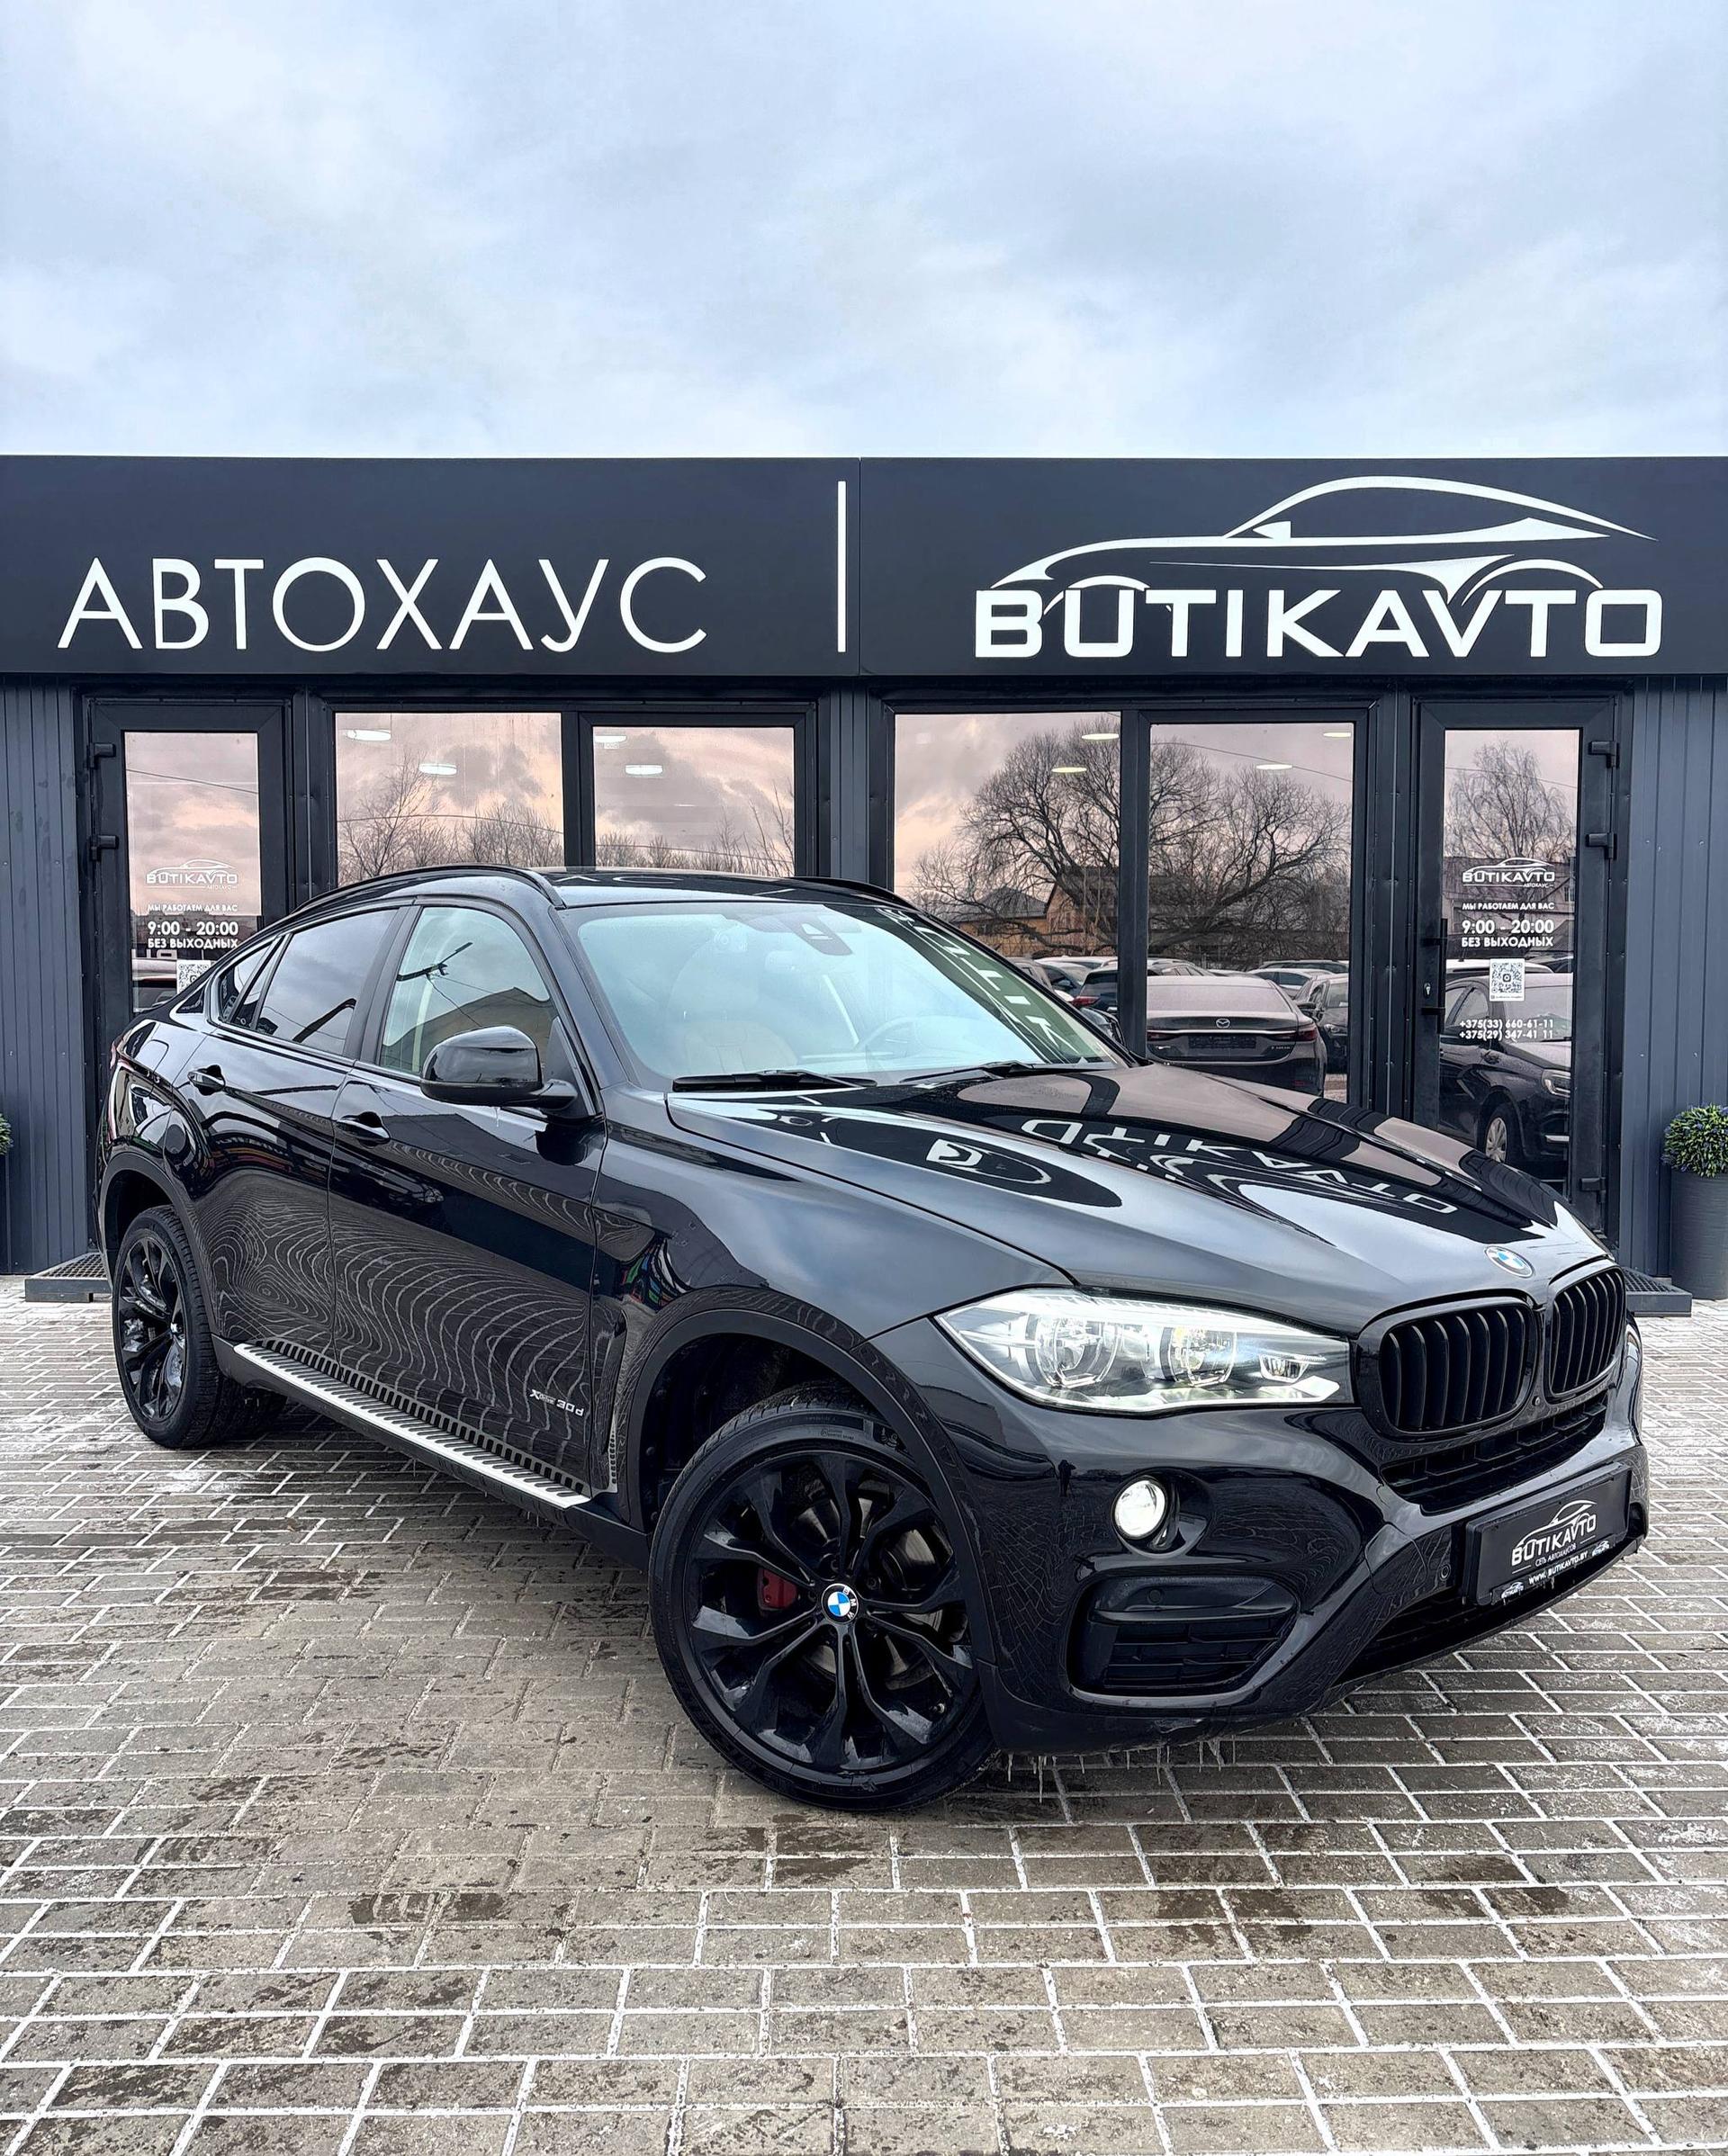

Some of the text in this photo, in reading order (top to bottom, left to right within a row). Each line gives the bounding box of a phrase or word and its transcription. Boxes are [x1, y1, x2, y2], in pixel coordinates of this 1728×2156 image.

[58, 556, 708, 653] АВТОХАУС
[975, 588, 1663, 659] BUTIKAVTO
[146, 873, 238, 884] BUTIKAVTO
[1462, 871, 1555, 883] BUTIKAVTO
[148, 903, 238, 912] МЫ РАБОТАЕМ ДЛЯ ВАС
[1520, 903, 1536, 911] ДЛЯ
[147, 921, 181, 936] 9:00
[195, 921, 239, 936] 20:00
[1462, 920, 1495, 934] 9:00
[1511, 919, 1555, 934] 20:00
[148, 938, 238, 949] БЕЗ ВЫХОДНЫХ
[1461, 936, 1554, 948] БЕЗ ВЫХОДНЫХ
[1460, 1019, 1553, 1031] +375(33) 660-61-11
[1460, 1029, 1503, 1041] +375(29)
[1511, 1514, 1597, 1566] BUTIKAVTO
